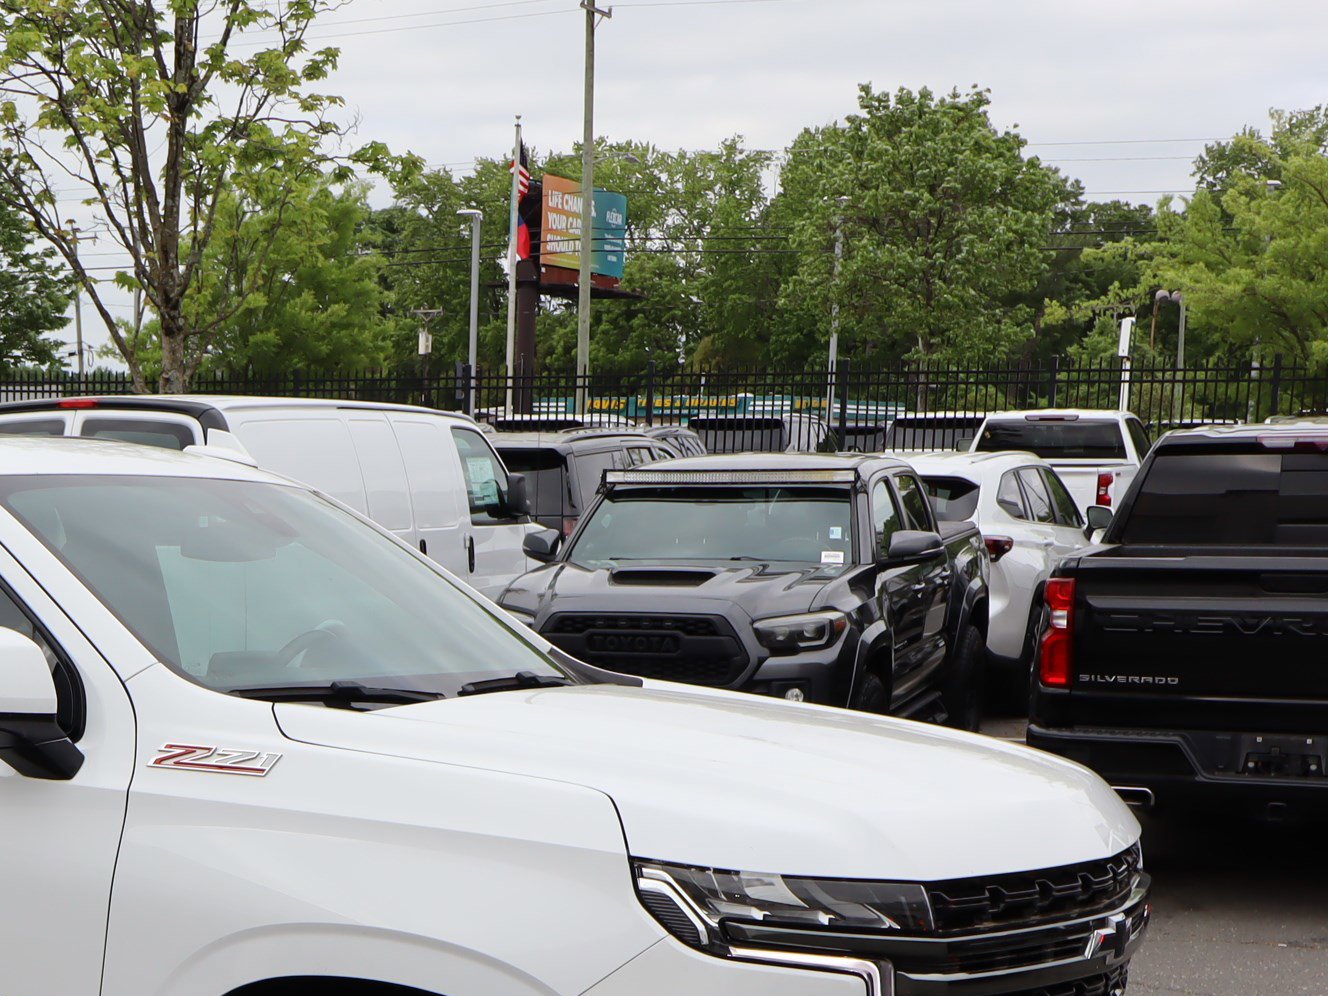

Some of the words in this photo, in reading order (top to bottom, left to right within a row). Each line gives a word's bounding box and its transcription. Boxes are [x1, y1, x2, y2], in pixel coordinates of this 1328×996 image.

[548, 190, 563, 209] LIFE
[564, 194, 597, 217] CHANS.
[547, 211, 567, 232] YOUR
[1101, 613, 1328, 636] CHEVR
[593, 635, 674, 650] TOYOTA
[1079, 674, 1179, 685] SILVERADO
[147, 743, 283, 777] Z71
